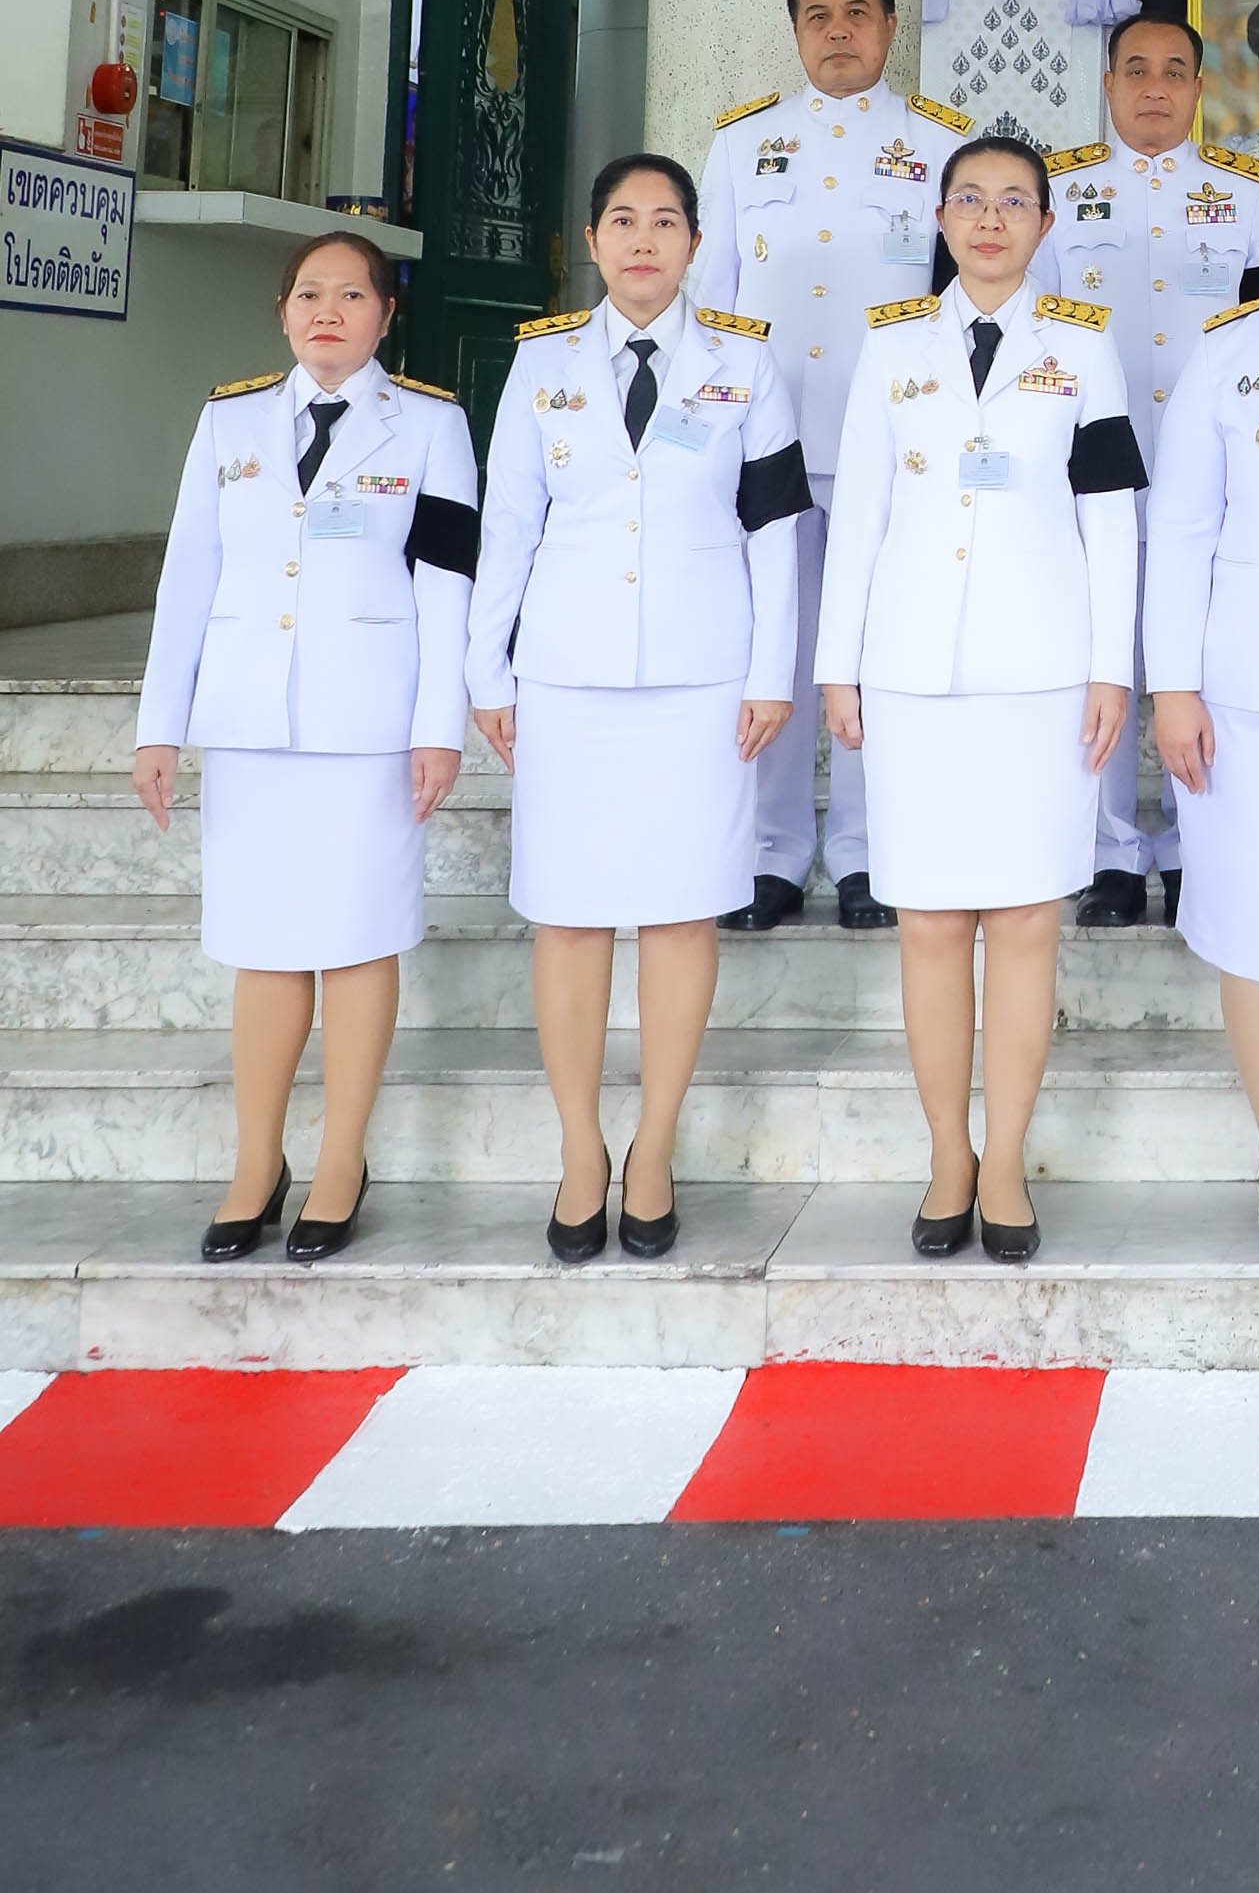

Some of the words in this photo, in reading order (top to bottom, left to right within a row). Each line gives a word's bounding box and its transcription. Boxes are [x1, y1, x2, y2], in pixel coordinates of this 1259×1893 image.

[8, 168, 126, 245] เขตควบคุม
[4, 231, 121, 298] โปรดติดบัตร
